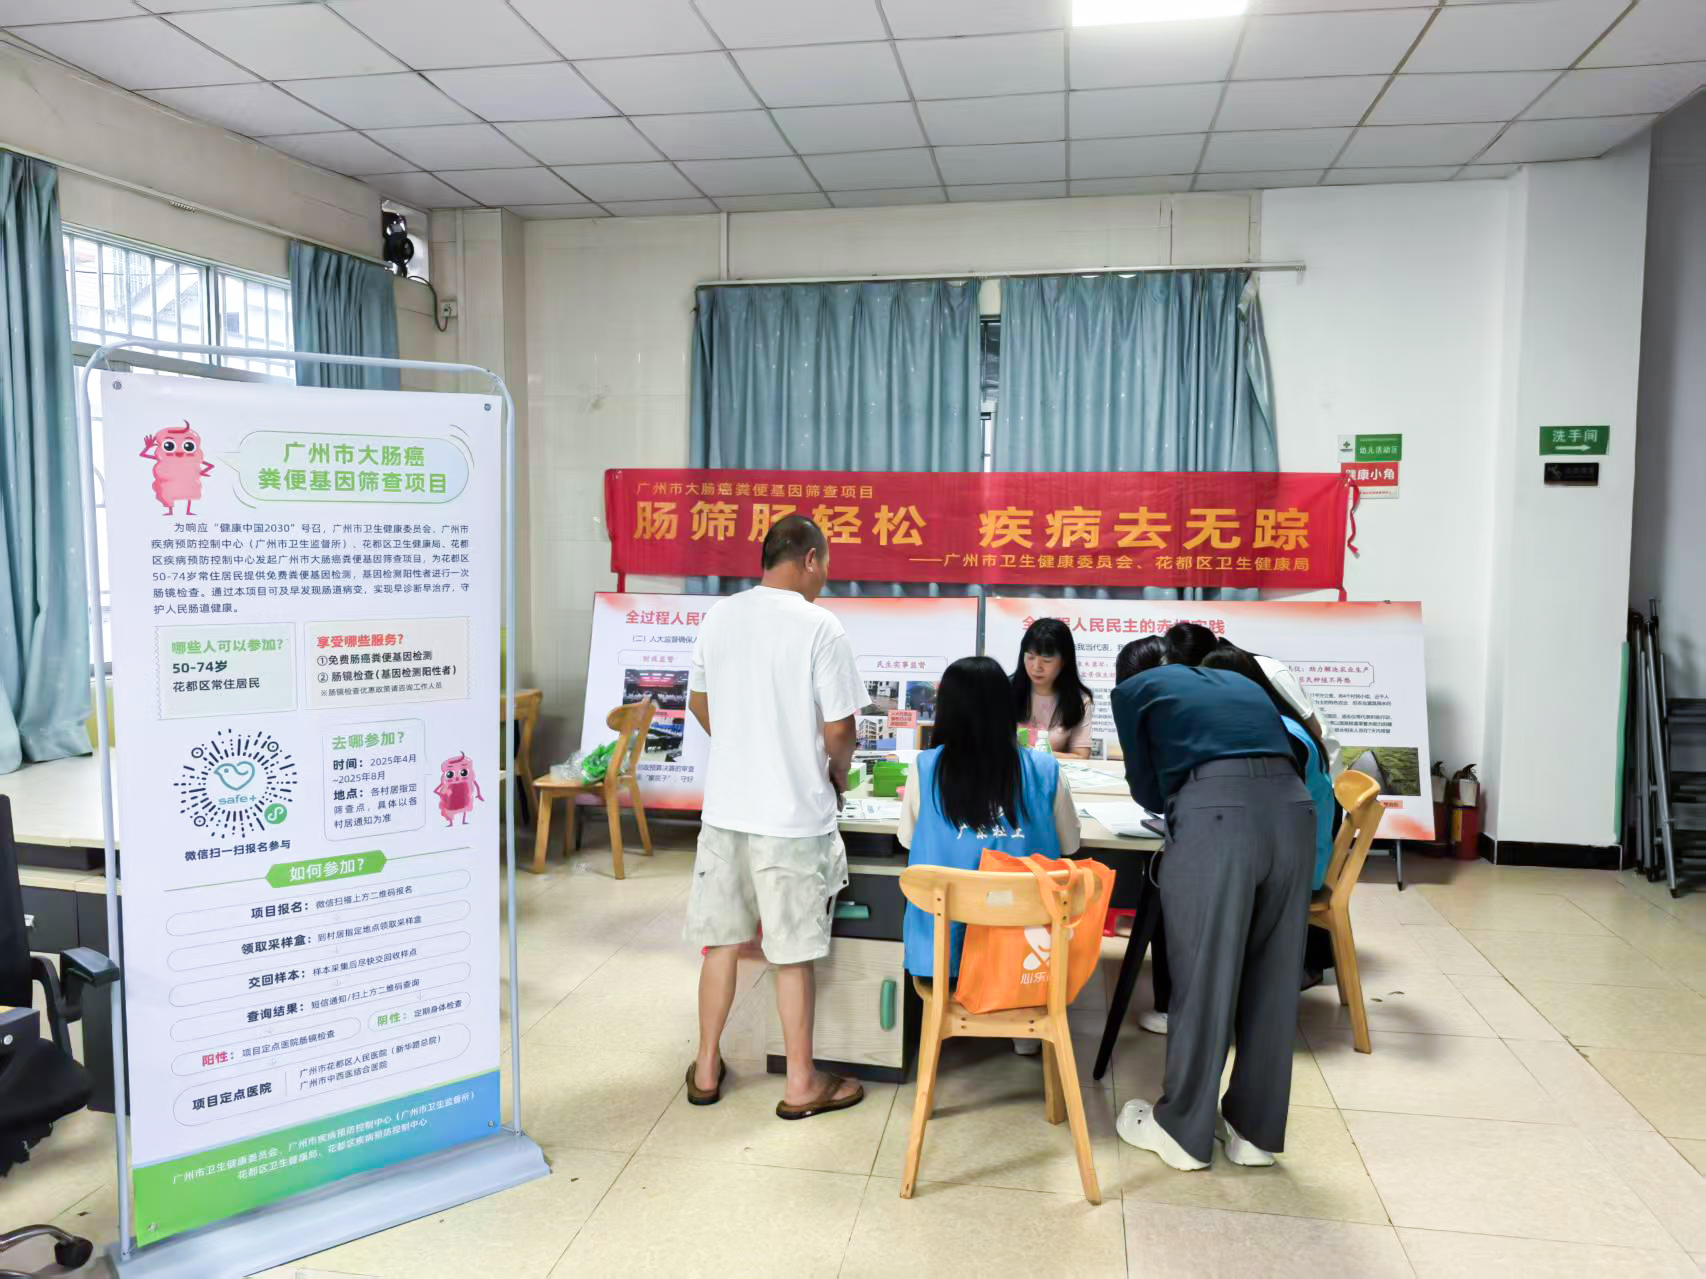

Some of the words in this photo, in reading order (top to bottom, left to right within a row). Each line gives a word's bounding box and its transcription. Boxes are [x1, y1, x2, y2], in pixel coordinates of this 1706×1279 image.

[1552, 429, 1598, 443] 洗手间
[283, 441, 425, 467] 广州市大肠癌
[258, 468, 447, 494] 粪便基因筛查项目
[636, 482, 874, 499] 广州市大肠癌粪便基因筛查项目
[633, 500, 927, 546] 肠筛肠轻松
[978, 506, 1309, 550] 疾病去无踪
[153, 603, 238, 615] 护人民肠道健康。
[625, 609, 706, 626] 全过程人民
[171, 639, 284, 655] 哪些人可以参加？
[316, 634, 404, 649] 享受哪些服务？
[172, 660, 228, 673] 50-74岁
[172, 677, 260, 693] 花都区常住居民
[331, 731, 405, 750] 去哪参加？
[334, 813, 392, 829] 村居通知为准
[184, 839, 291, 861] 微信扫一扫报名参与
[289, 858, 365, 882] 如何参加？
[192, 1082, 272, 1111] 项目定点医院
